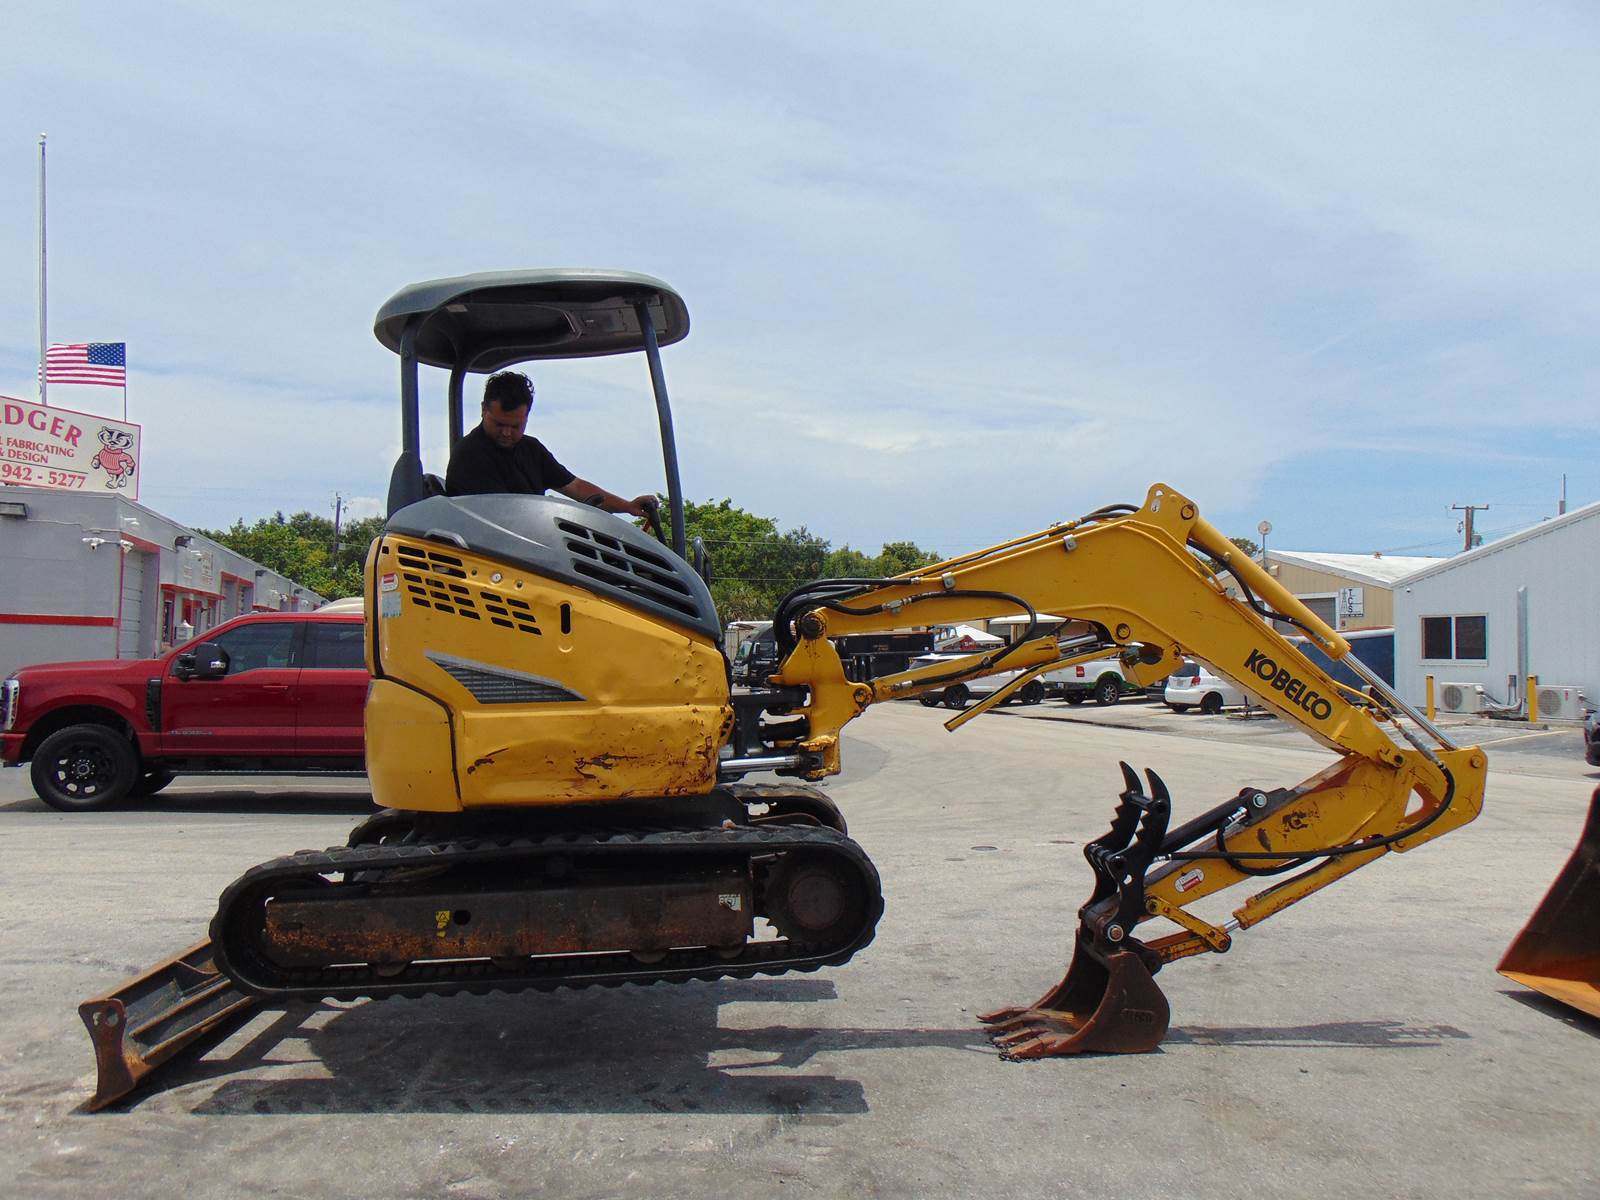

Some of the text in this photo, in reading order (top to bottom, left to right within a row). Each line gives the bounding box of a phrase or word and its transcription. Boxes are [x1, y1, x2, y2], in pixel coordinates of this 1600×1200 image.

[0, 404, 82, 447] DGER
[6, 437, 75, 457] FABRICATING
[7, 448, 49, 464] DESIGN
[1, 463, 33, 481] 942
[48, 471, 87, 488] 5277
[1243, 648, 1332, 720] KOBELCO
